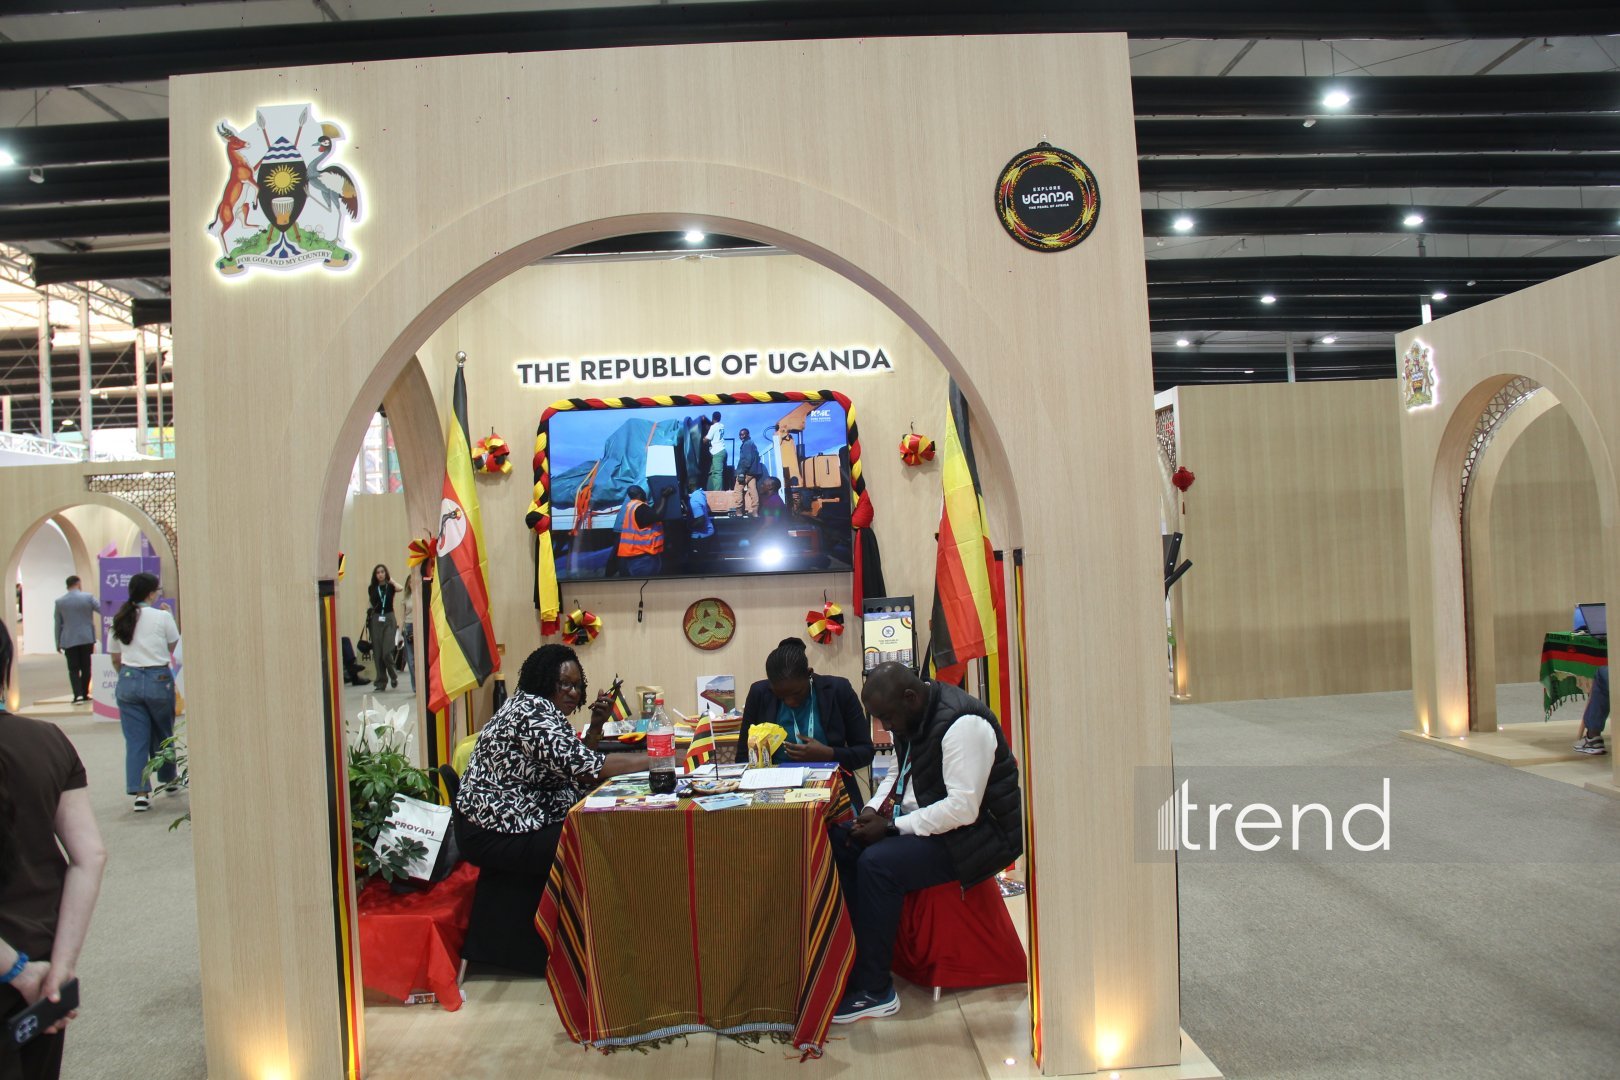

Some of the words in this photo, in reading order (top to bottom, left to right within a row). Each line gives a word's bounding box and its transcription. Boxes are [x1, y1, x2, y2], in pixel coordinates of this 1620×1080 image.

[1022, 191, 1074, 204] UGANDA
[286, 257, 298, 265] MY
[297, 251, 331, 262] COUNTRY
[517, 362, 570, 383] THE
[580, 355, 711, 380] REPUBLIC
[721, 354, 758, 375] OF
[768, 348, 891, 374] UGANDA
[394, 821, 435, 837] PROYAPI
